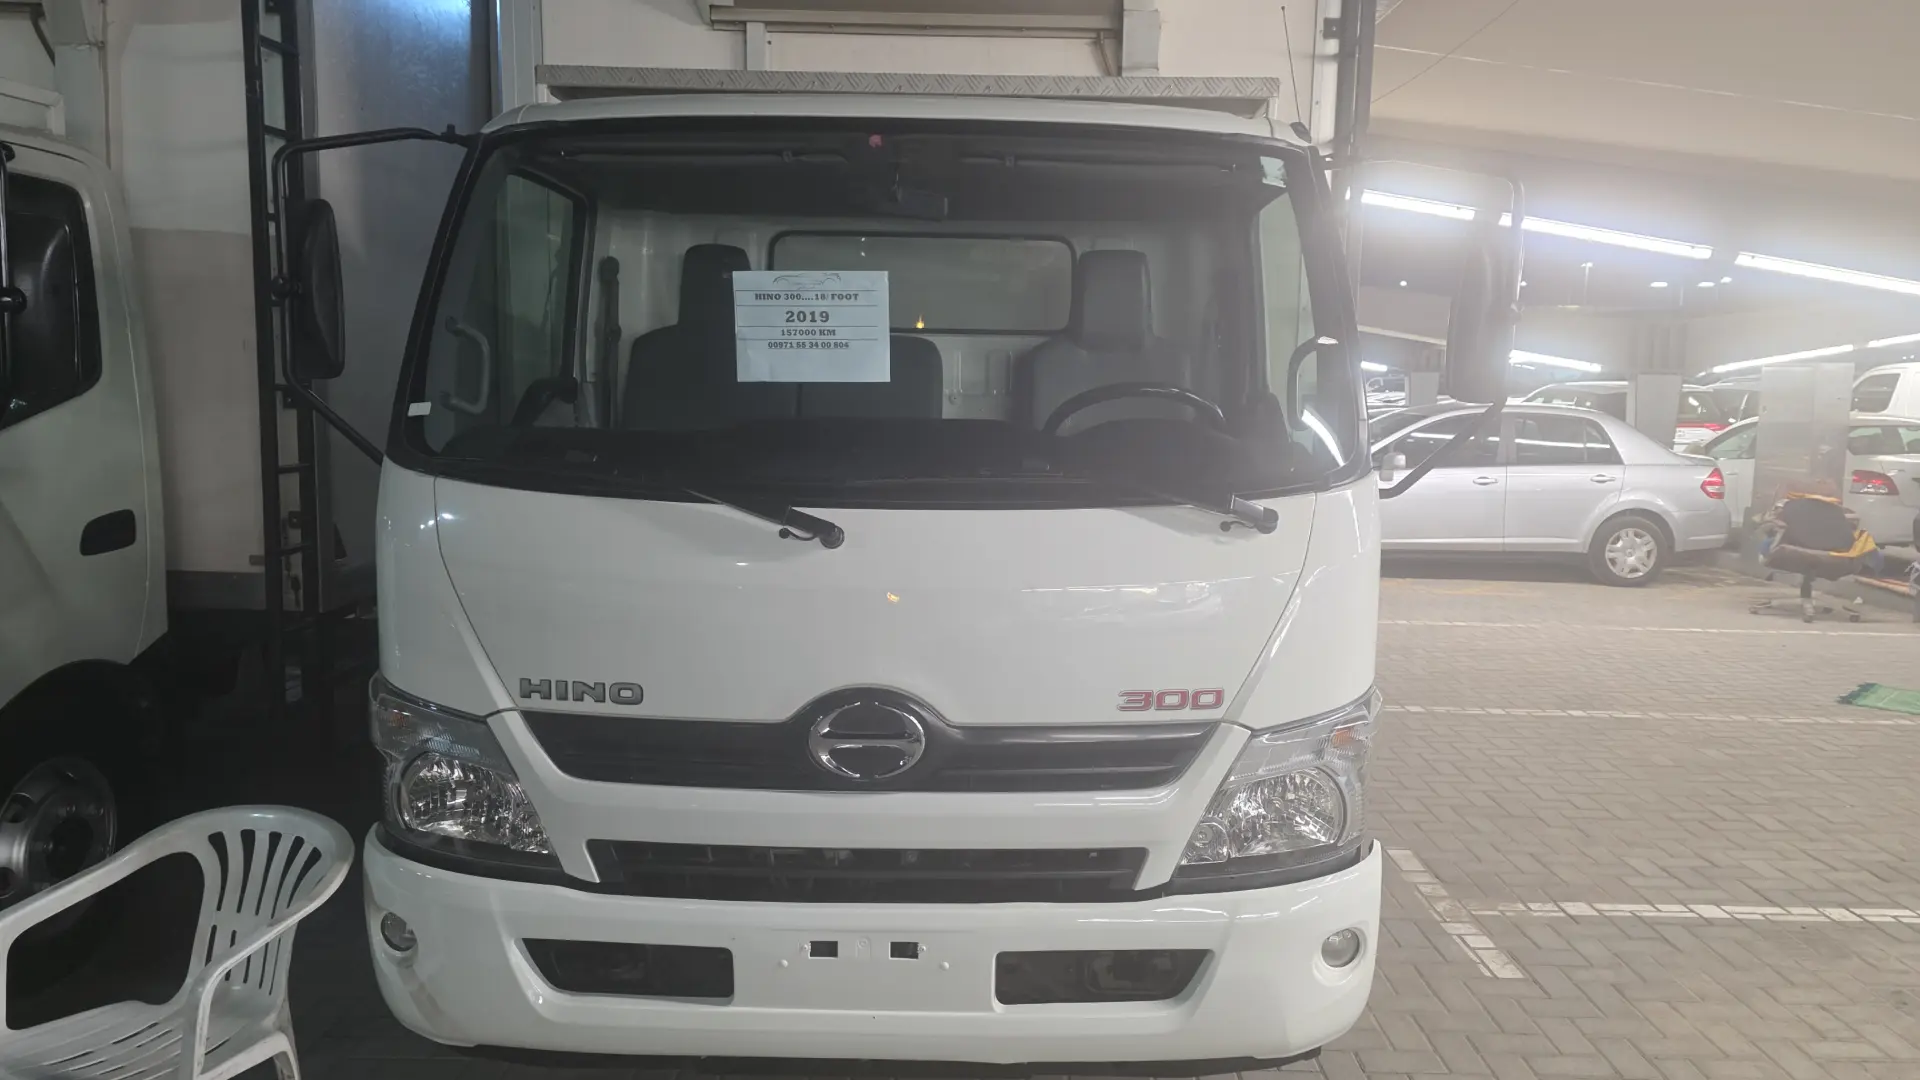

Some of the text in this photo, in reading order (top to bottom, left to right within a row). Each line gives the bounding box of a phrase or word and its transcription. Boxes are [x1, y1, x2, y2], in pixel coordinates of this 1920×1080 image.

[755, 293, 781, 301] HINO
[785, 310, 830, 323] 2019
[519, 677, 644, 705] HINO
[1117, 688, 1224, 711] 300
